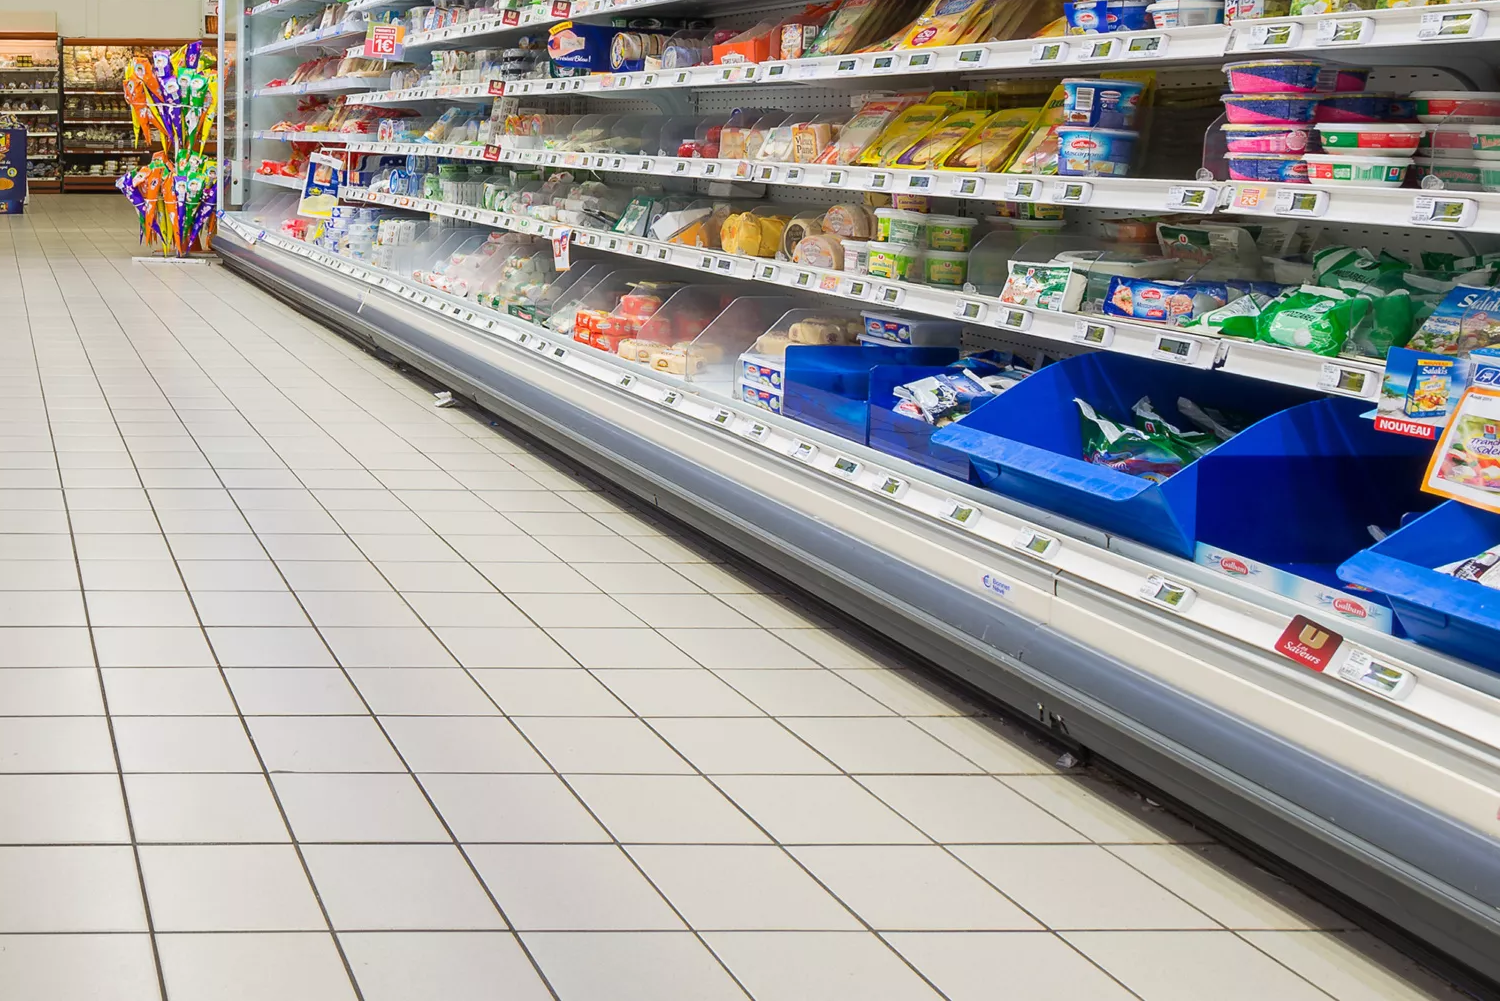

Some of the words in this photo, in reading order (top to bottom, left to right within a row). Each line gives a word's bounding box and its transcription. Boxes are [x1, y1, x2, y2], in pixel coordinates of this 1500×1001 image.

[375, 39, 393, 53] 1€
[1240, 195, 1258, 206] 2€
[1422, 366, 1448, 375] Salakis
[1379, 419, 1431, 437] NOUVEAU
[1221, 557, 1249, 575] Galbani
[1334, 598, 1366, 618] Galbani
[1299, 624, 1330, 650] U
[1283, 641, 1321, 665] Saveurs
